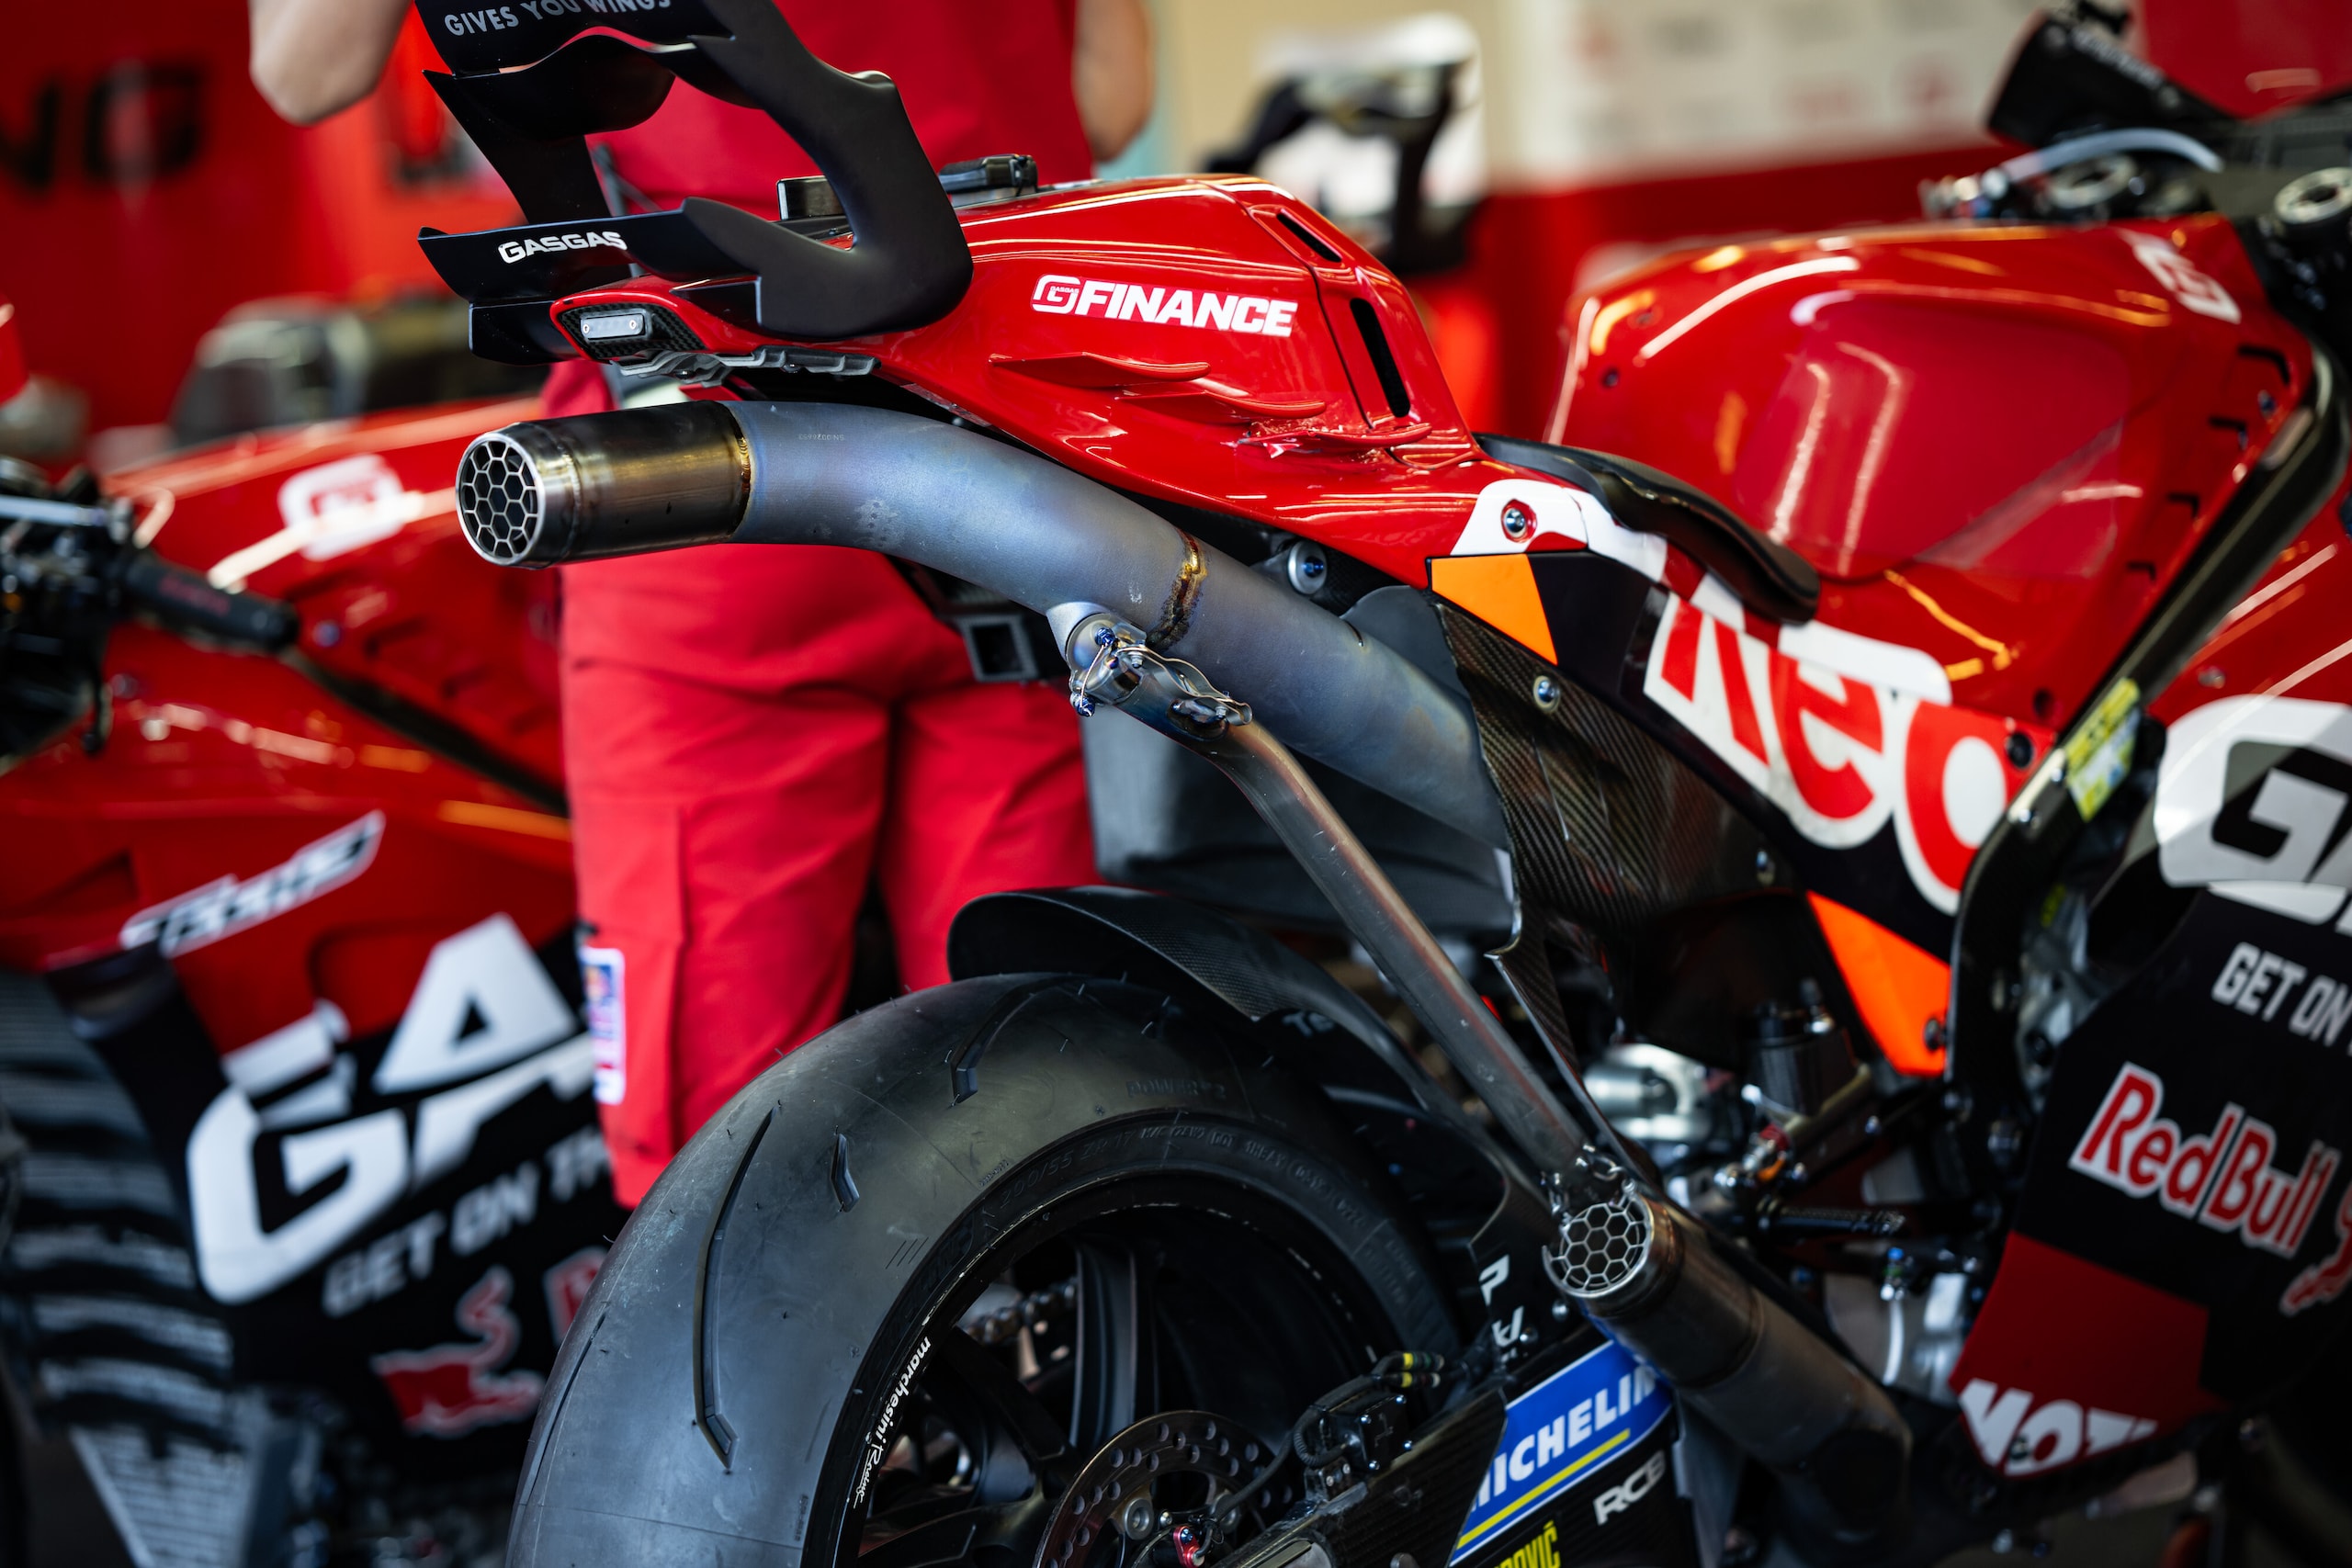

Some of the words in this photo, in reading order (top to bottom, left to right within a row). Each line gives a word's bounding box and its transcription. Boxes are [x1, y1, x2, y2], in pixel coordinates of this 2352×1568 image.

[443, 6, 519, 36] GIVES
[497, 231, 628, 264] GASGAS
[1074, 279, 1299, 337] FINANCE
[2211, 941, 2309, 1022] GET
[2289, 975, 2352, 1048] ON
[875, 1336, 933, 1445] marchesini
